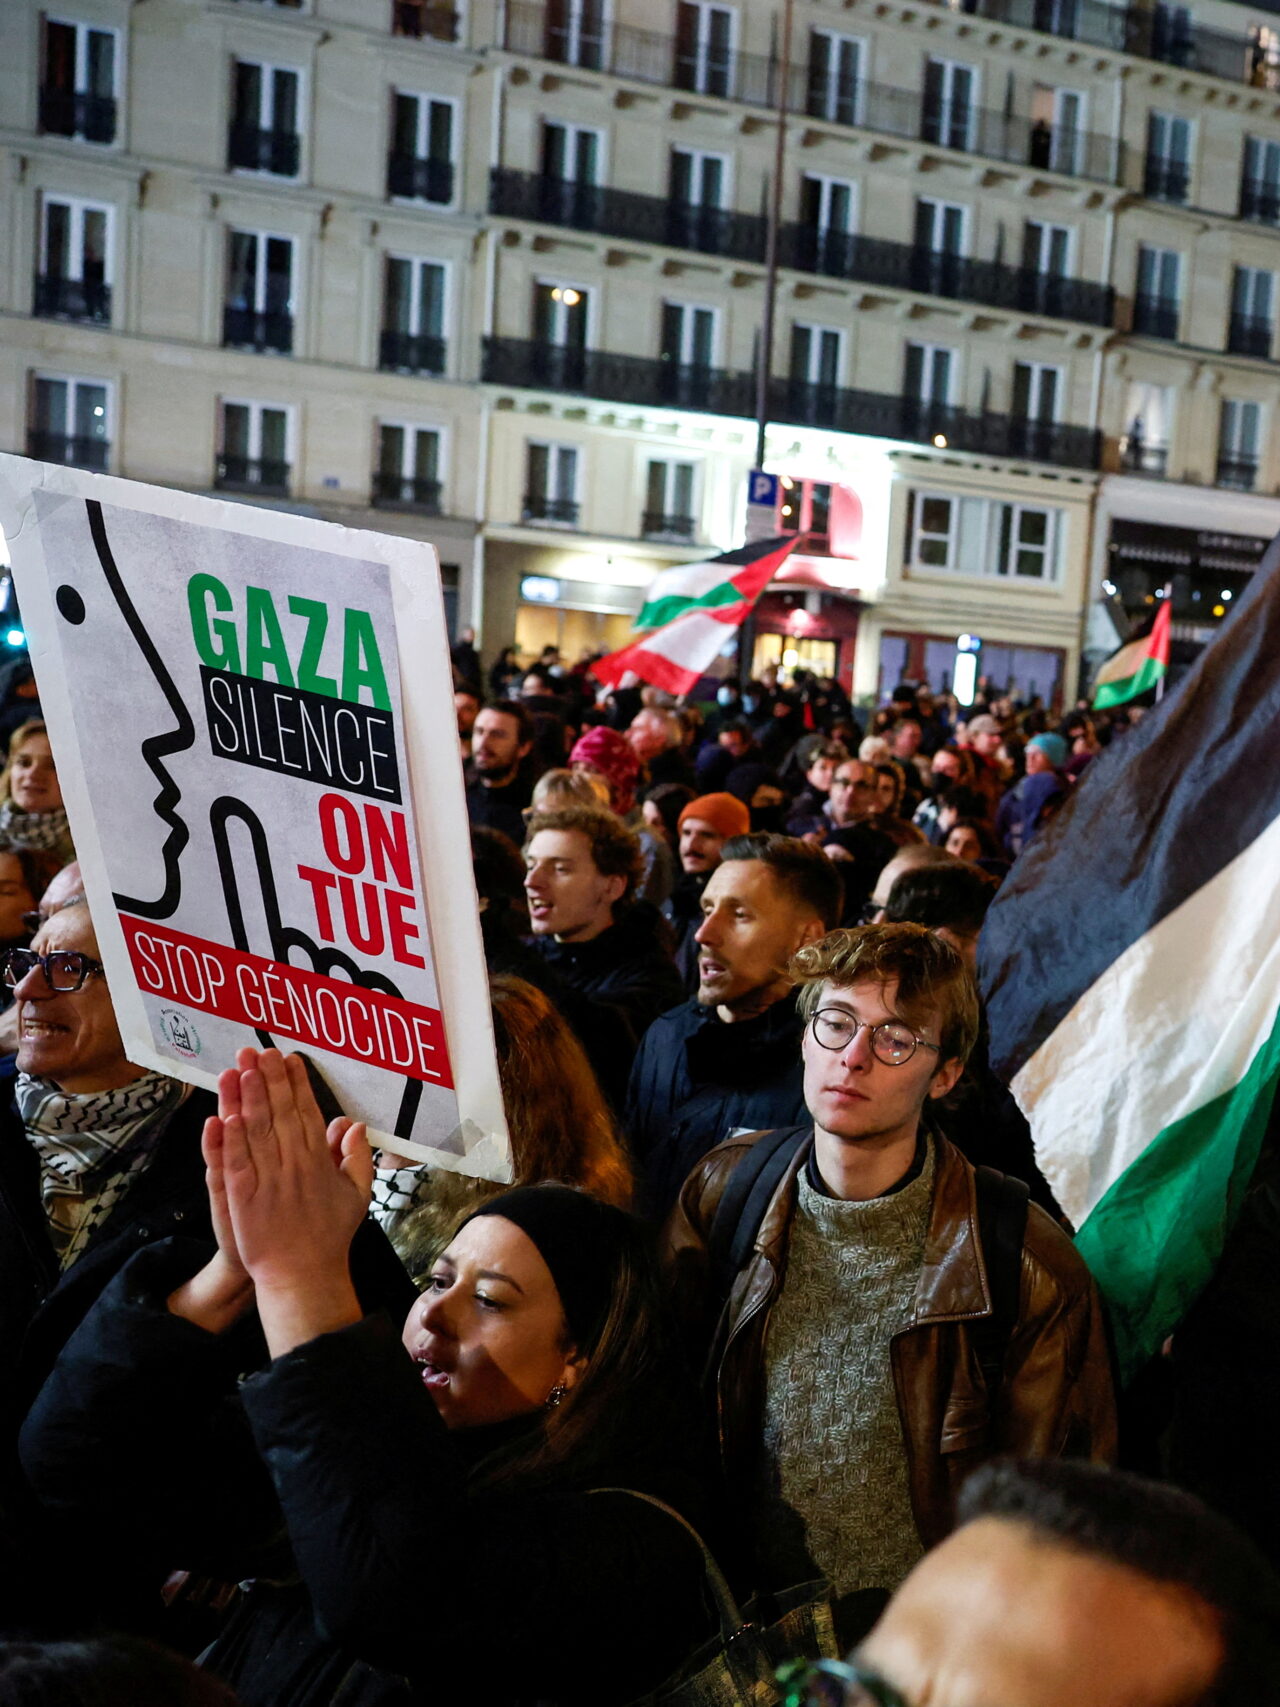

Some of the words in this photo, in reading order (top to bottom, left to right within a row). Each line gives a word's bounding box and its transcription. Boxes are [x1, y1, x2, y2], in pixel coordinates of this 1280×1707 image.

[754, 475, 772, 501] P
[187, 572, 393, 712] GAZA
[209, 676, 395, 794] SILENCE
[319, 793, 413, 891] ON
[297, 864, 426, 970] TUE
[134, 931, 225, 1008] STOP
[236, 963, 441, 1078] GÉNOCIDE
